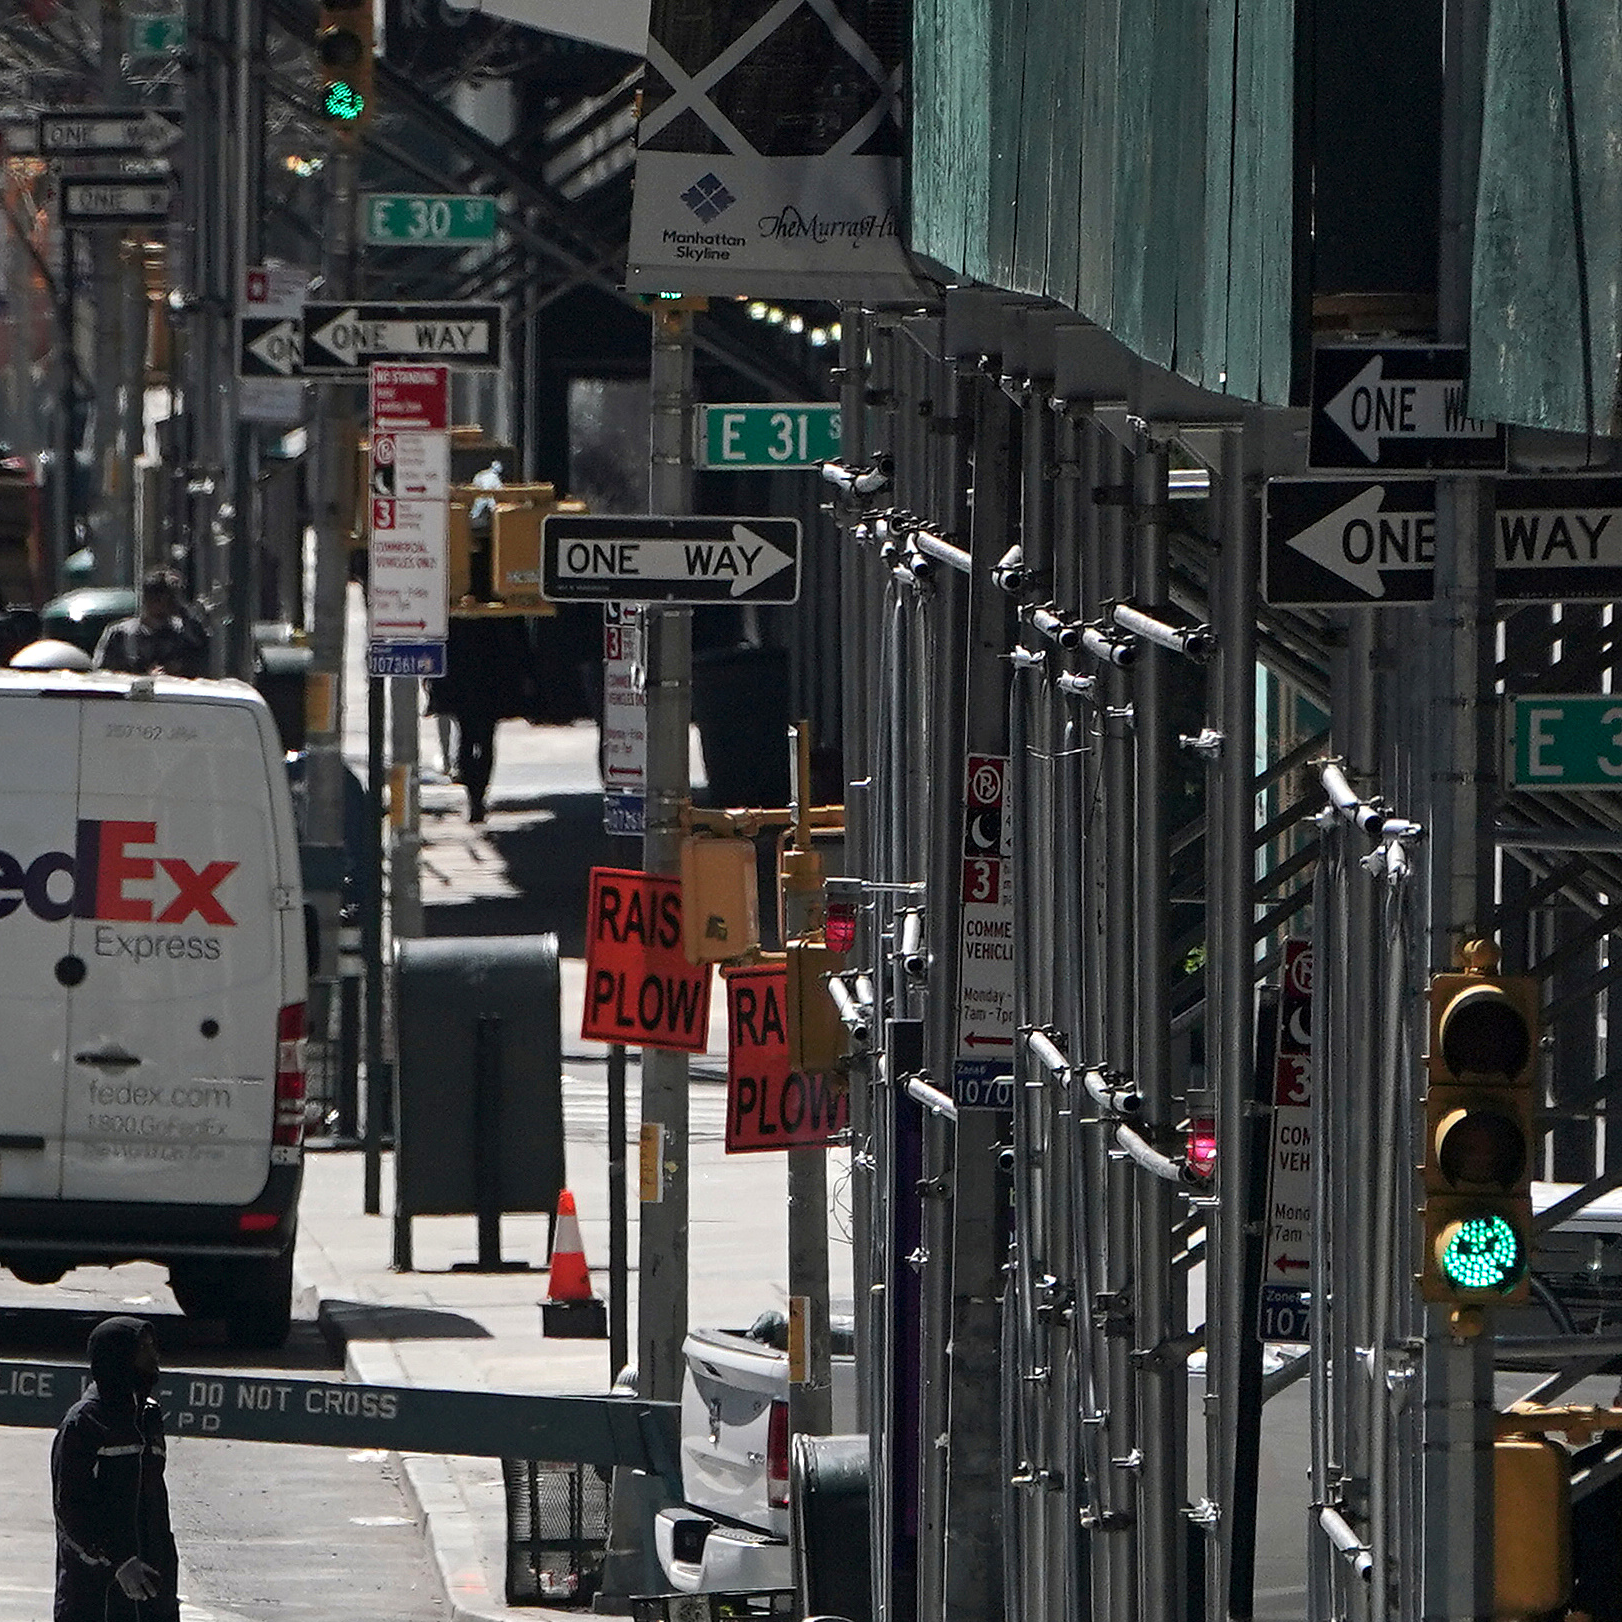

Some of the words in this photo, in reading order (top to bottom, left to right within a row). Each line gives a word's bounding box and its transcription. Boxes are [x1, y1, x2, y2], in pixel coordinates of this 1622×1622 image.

[372, 201, 394, 237] E
[409, 201, 451, 237] 30
[662, 229, 746, 247] Manhattan
[675, 246, 730, 263] Skyline
[331, 322, 388, 350] ONE
[415, 325, 475, 349] WAY
[1351, 386, 1416, 432] ONE
[722, 413, 747, 461] E
[767, 413, 809, 461] 31
[1342, 518, 1436, 565] ONE
[1500, 514, 1612, 562] WAY
[568, 543, 640, 575] ONE
[685, 545, 763, 577] WAY
[1529, 709, 1564, 777] E
[971, 861, 991, 900] 3
[94, 925, 221, 964] Express
[591, 969, 701, 1035] PLOW
[963, 987, 1004, 1004] Monday
[735, 984, 785, 1047] RA
[89, 1078, 232, 1108] fedex.com
[734, 1072, 848, 1137] PLOW
[1275, 1226, 1301, 1242] 7am
[188, 1381, 224, 1409] DO
[237, 1384, 292, 1413] NOT
[306, 1388, 398, 1420] CROSS
